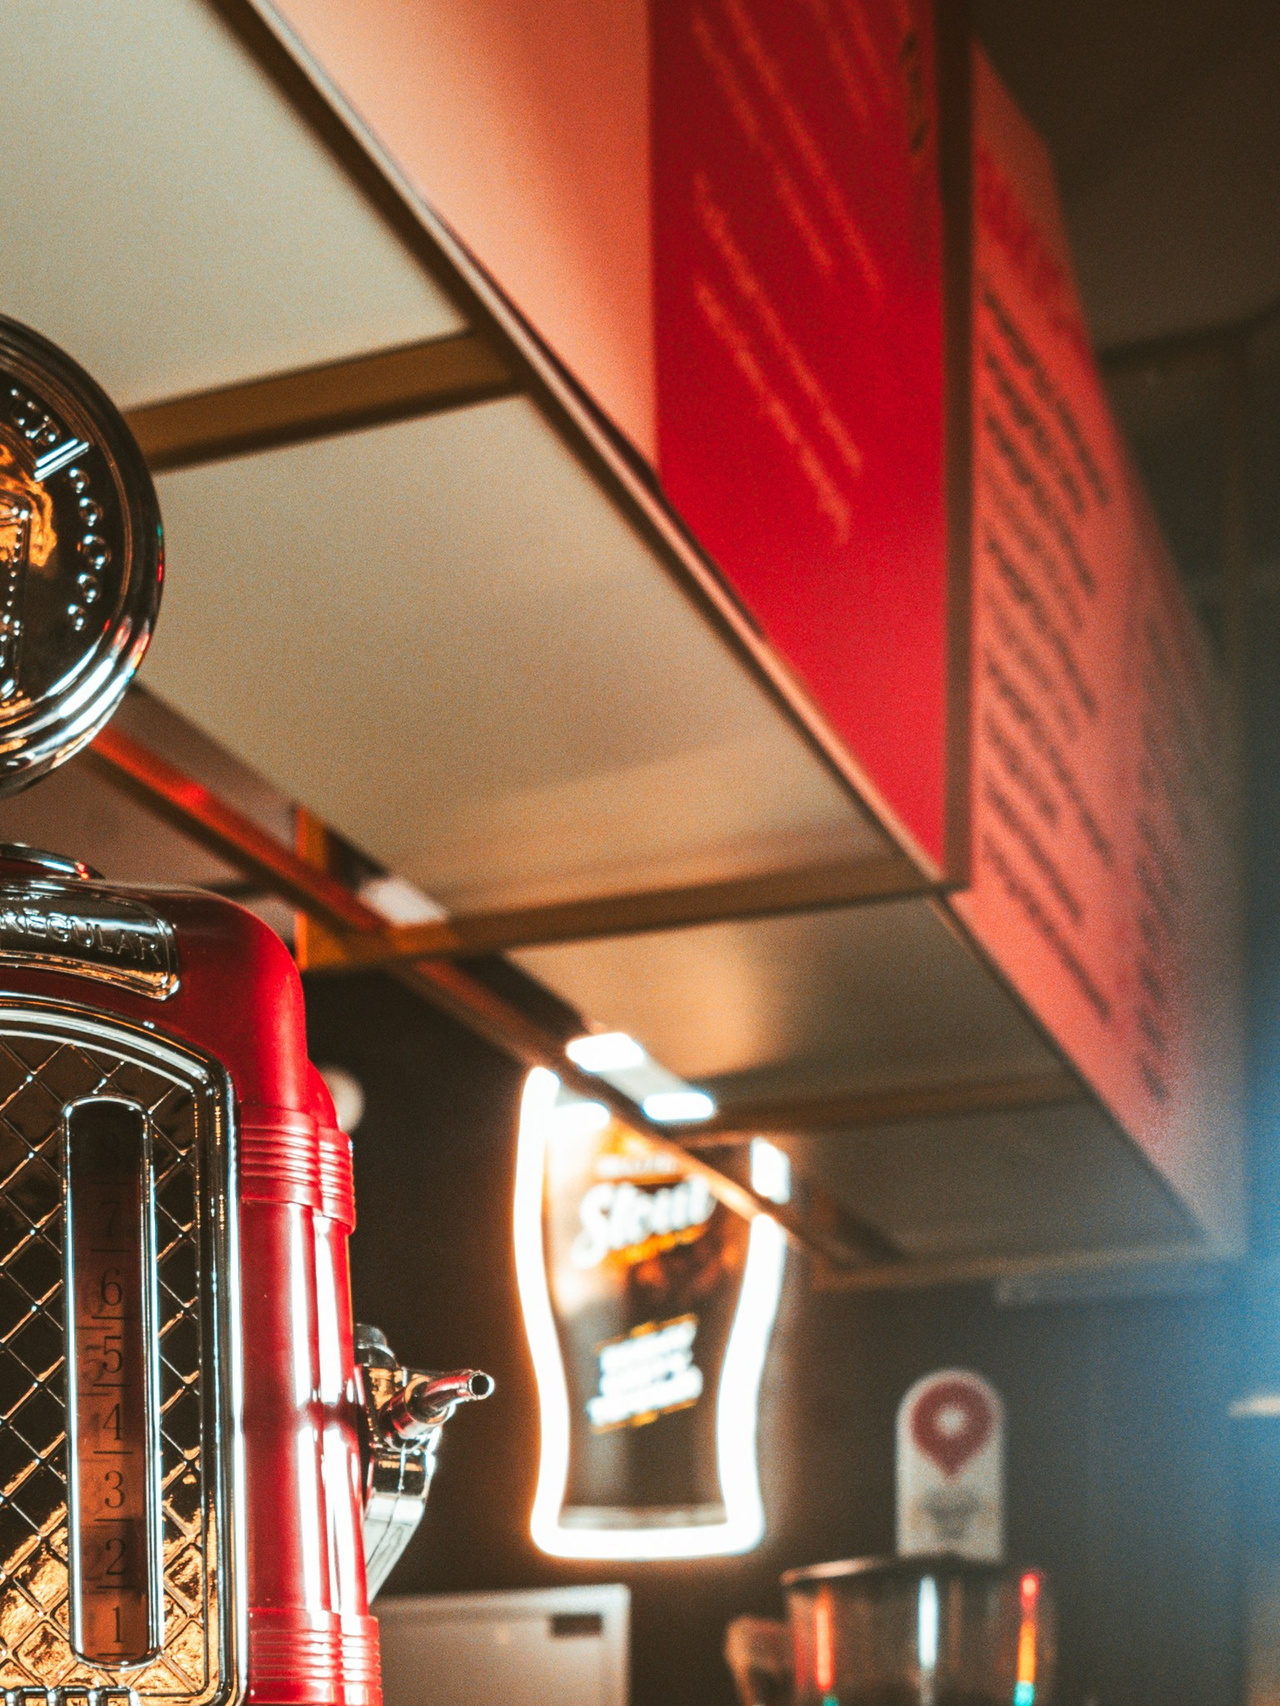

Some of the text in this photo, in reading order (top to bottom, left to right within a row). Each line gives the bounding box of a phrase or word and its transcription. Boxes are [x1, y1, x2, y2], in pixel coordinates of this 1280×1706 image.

[100, 1268, 123, 1306] 6
[101, 1336, 124, 1373] 5
[103, 1404, 123, 1441] 4
[104, 1471, 126, 1509] 3
[106, 1538, 128, 1576] 2
[112, 1607, 123, 1644] 1
